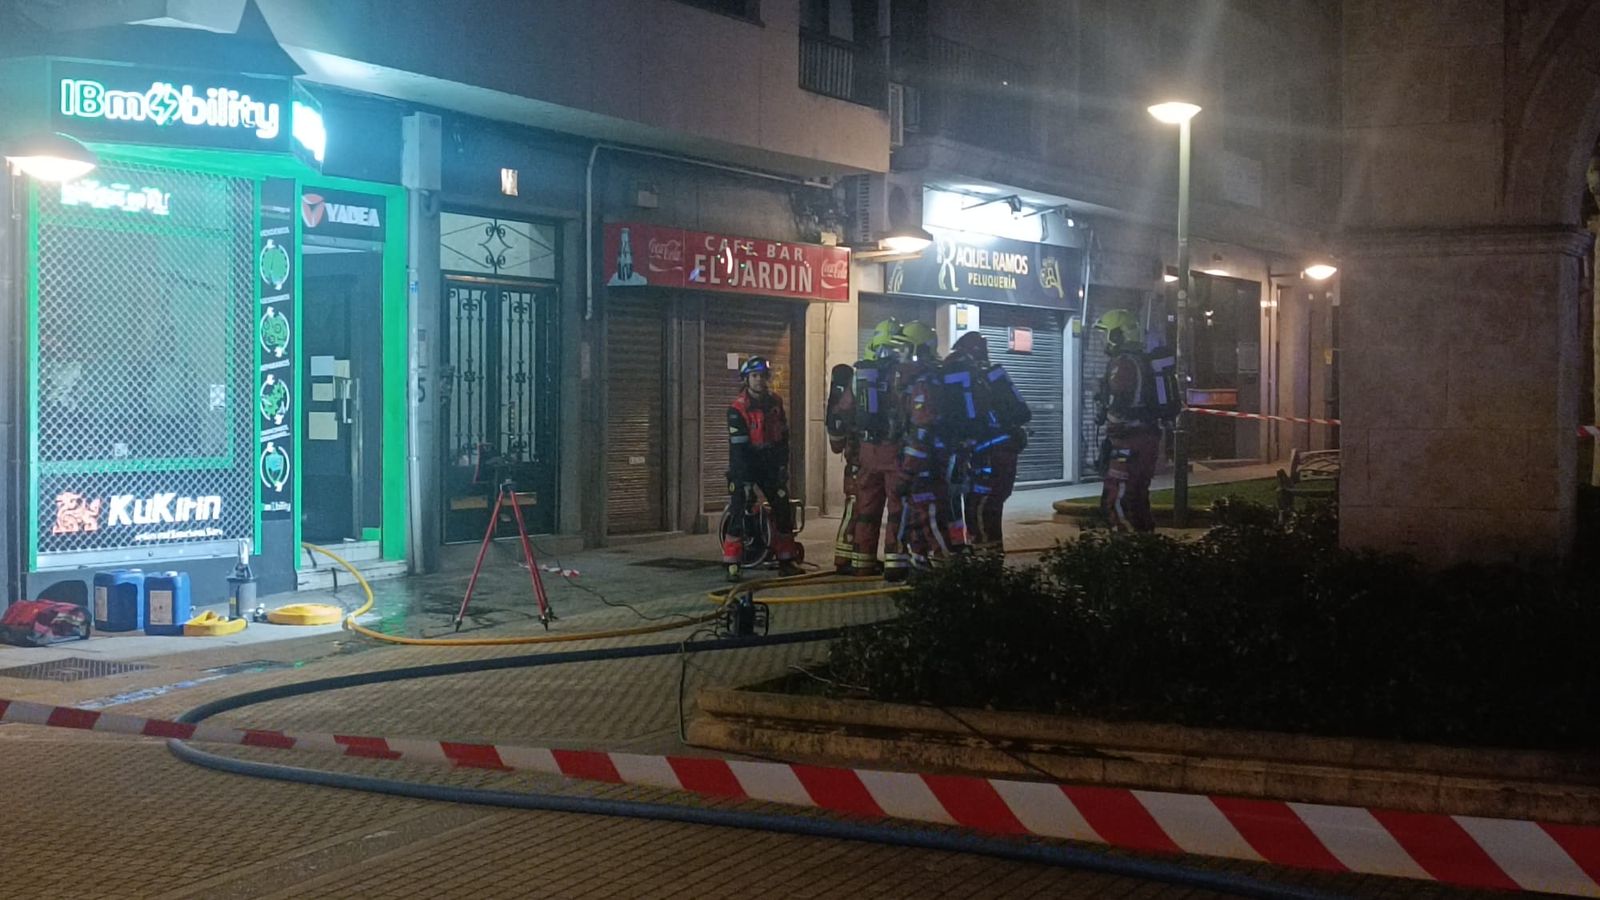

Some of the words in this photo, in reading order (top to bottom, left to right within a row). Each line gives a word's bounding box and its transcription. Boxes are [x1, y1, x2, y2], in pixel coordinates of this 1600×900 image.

[325, 202, 381, 228] YADEA
[766, 243, 804, 262] BAR
[992, 249, 1029, 275] RAMOS
[693, 254, 721, 285] EL
[730, 258, 813, 293] JARDIN
[967, 271, 1017, 290] PELUQUERÍA
